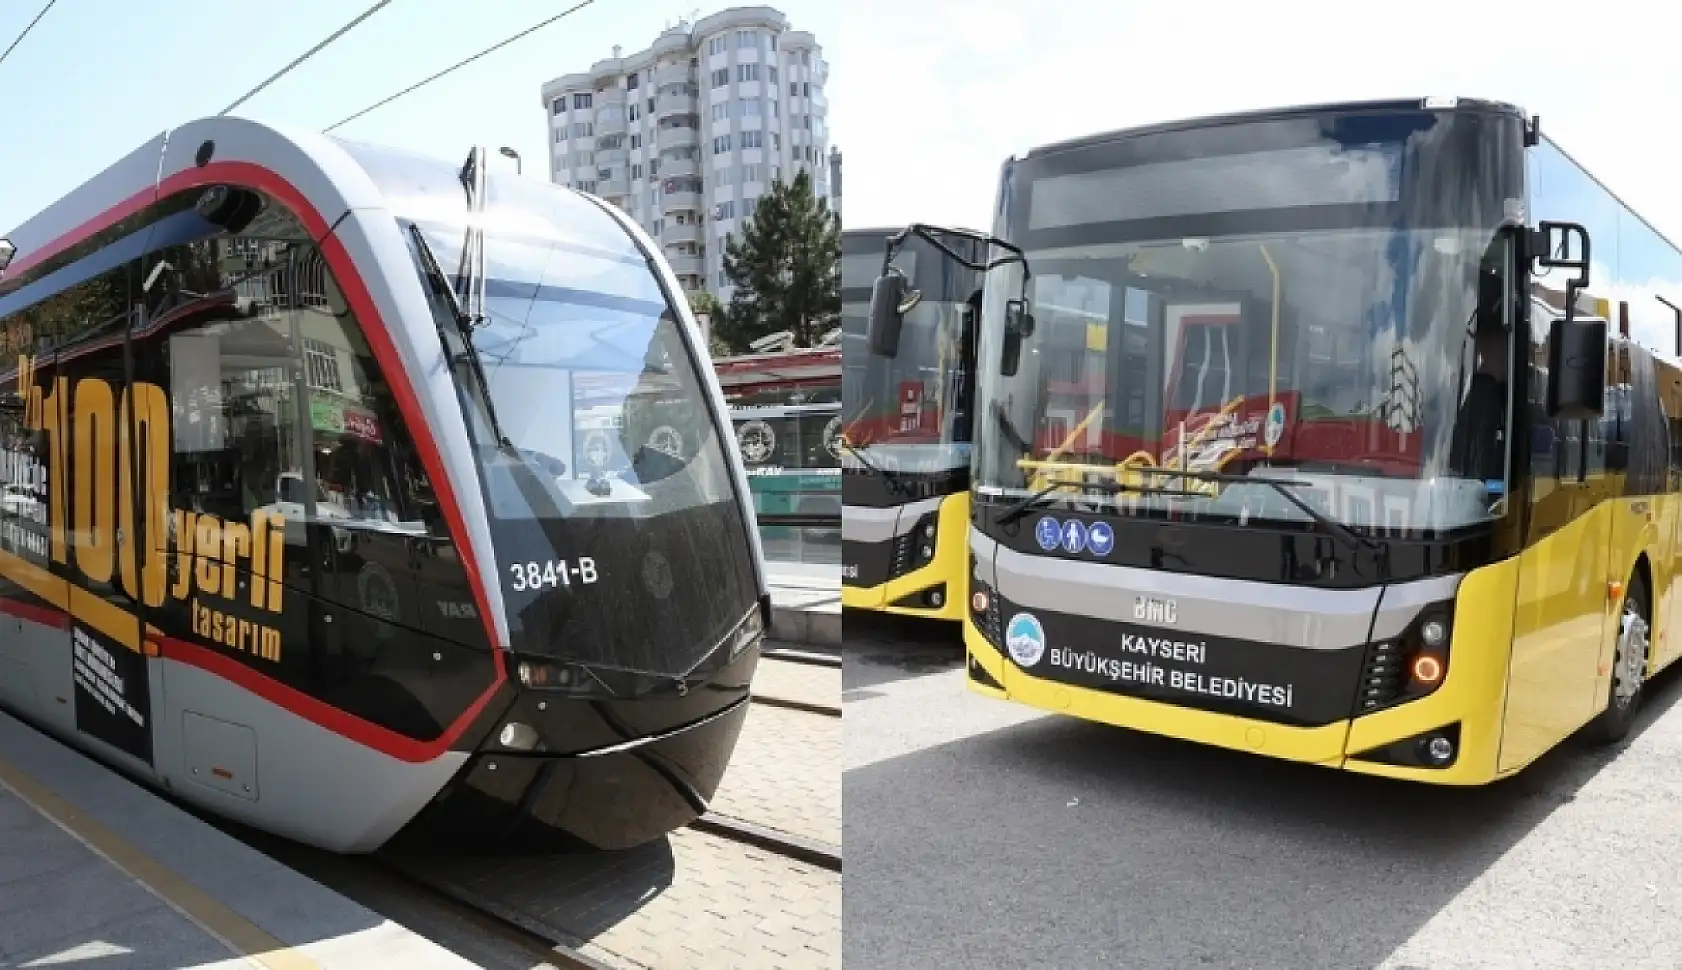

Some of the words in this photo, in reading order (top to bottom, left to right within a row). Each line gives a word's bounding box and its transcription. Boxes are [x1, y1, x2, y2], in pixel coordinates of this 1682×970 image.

[172, 508, 286, 614] yerli
[510, 556, 599, 591] 3841-B
[192, 597, 282, 663] tasarım
[1121, 632, 1206, 664] KAYSERİ
[1050, 645, 1164, 686] BÜYÜKŞEHİR
[1171, 669, 1293, 708] BELEDİYESİ
